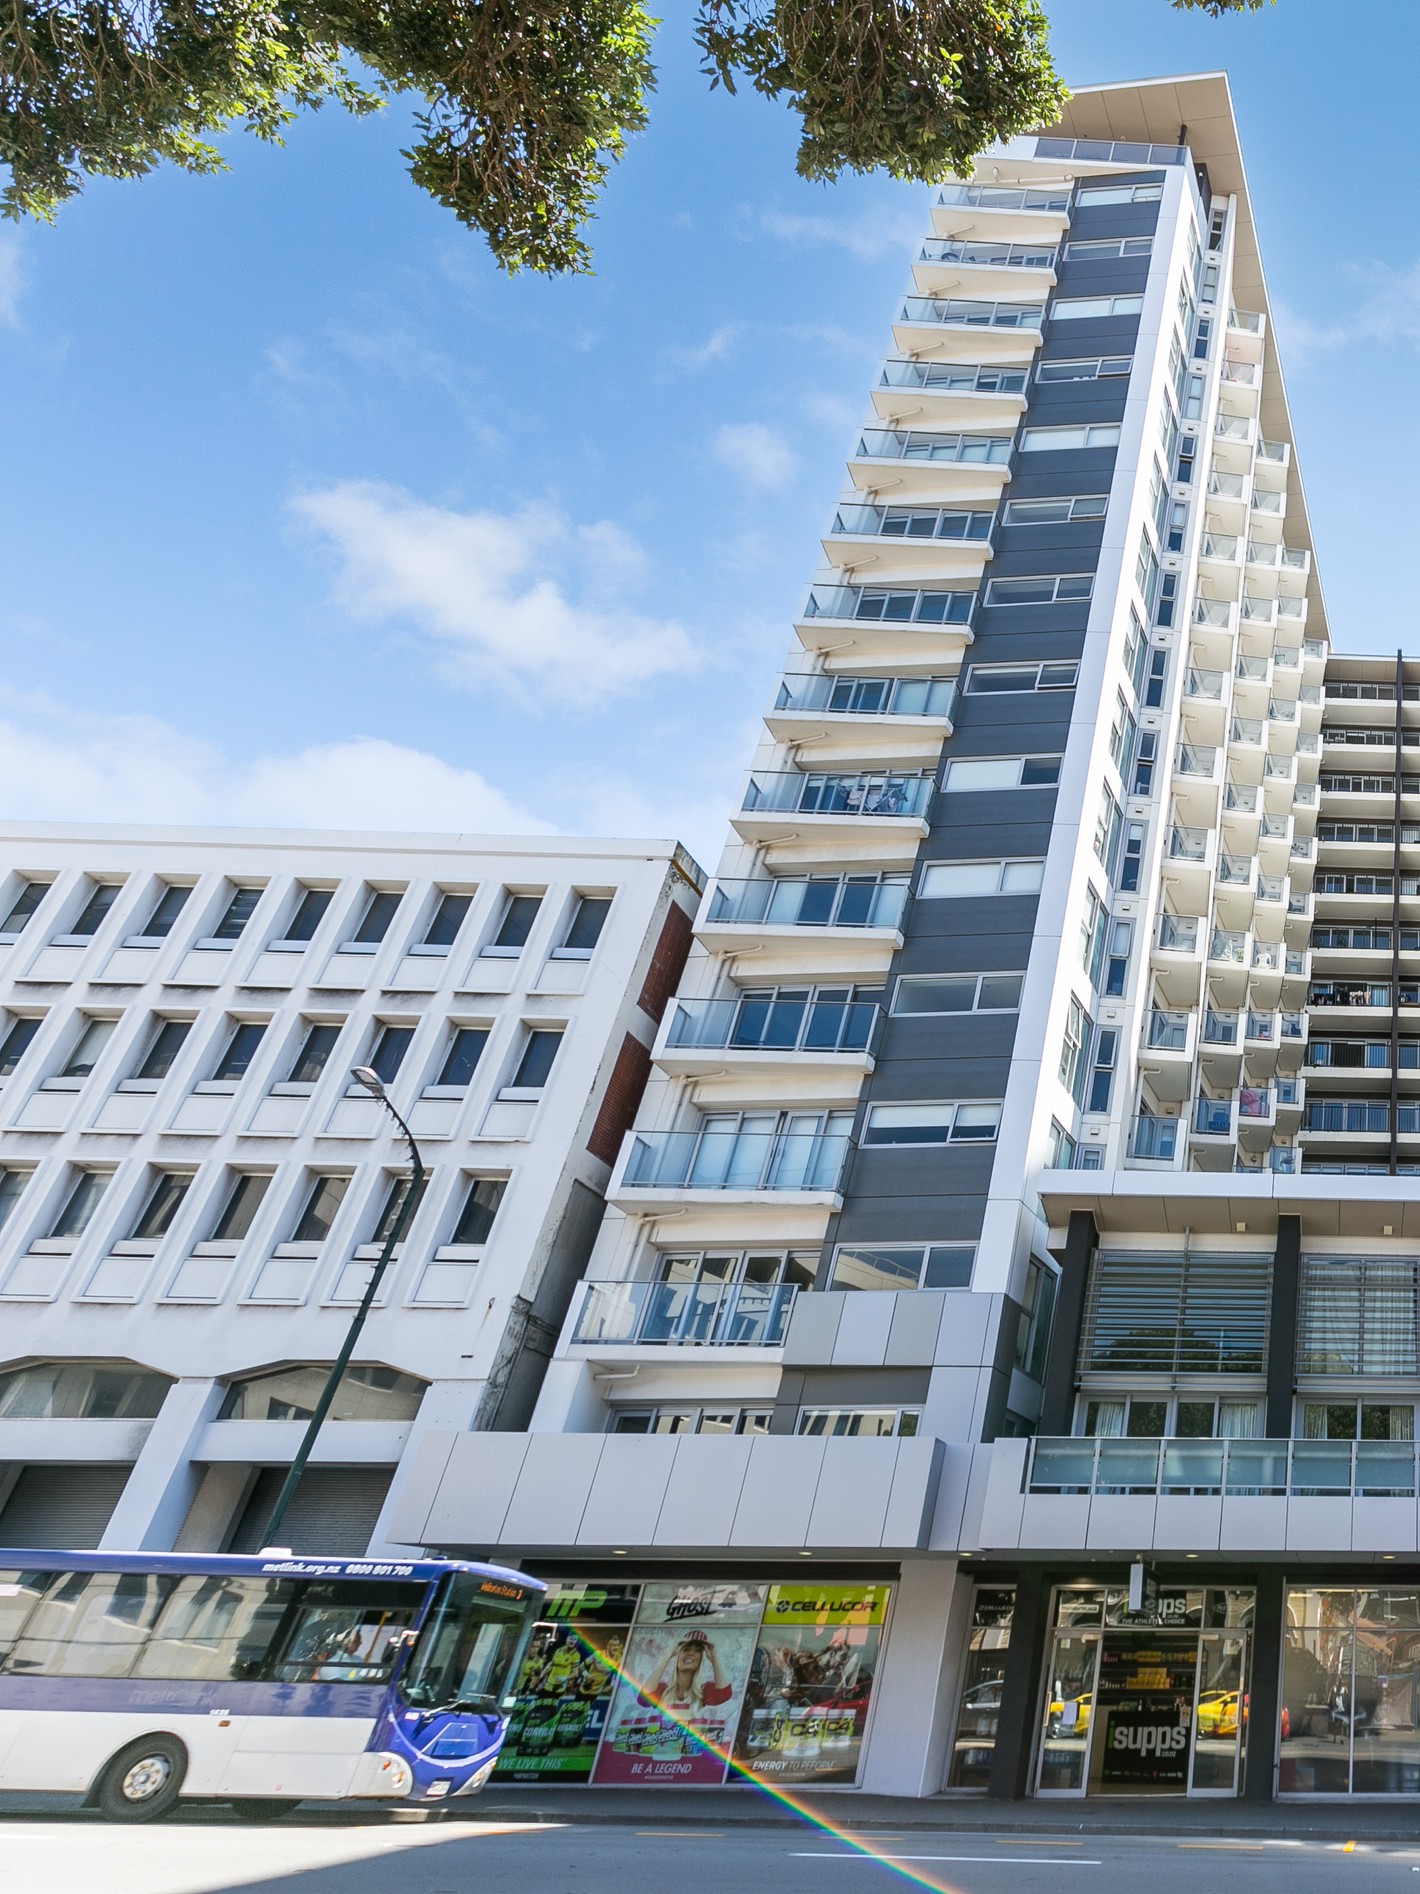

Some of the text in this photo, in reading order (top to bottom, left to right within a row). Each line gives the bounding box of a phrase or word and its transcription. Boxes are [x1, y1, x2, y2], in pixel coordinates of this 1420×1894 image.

[262, 1562, 341, 1575] metlink.org.nz
[345, 1564, 371, 1575] 0800
[664, 1590, 724, 1622] GHOST
[790, 1601, 876, 1612] CELLUCOR
[1108, 1721, 1186, 1757] isupps
[500, 1759, 561, 1769] WE LIVE THIS
[631, 1763, 692, 1774] BE A LEGEND
[752, 1761, 788, 1771] ENERGY
[789, 1761, 799, 1770] TO
